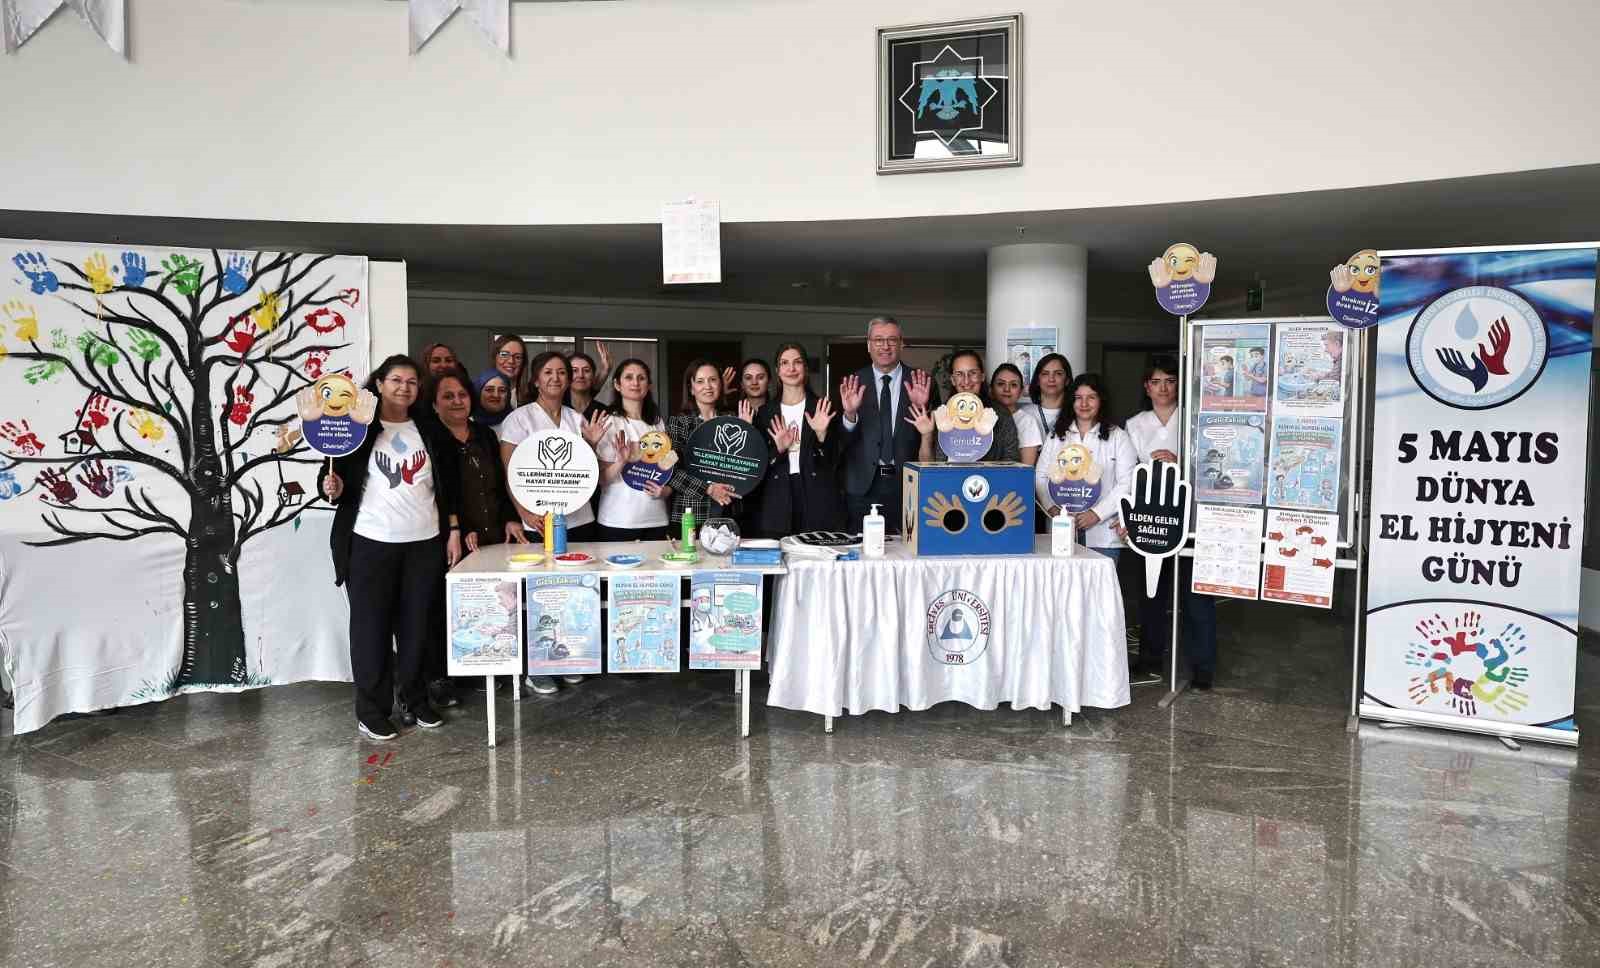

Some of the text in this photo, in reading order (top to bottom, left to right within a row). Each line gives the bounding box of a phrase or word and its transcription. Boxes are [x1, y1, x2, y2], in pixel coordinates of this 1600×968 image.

[1398, 429, 1559, 464] 5 MAYIS
[1415, 471, 1535, 507] DÜNYA
[1129, 512, 1179, 526] ELDEN GELEN
[1137, 524, 1168, 536] SAĞLIK!
[1379, 511, 1572, 550] EL HİJYENİ
[1421, 552, 1522, 588] GÜNÜ
[946, 654, 964, 664] 1978
